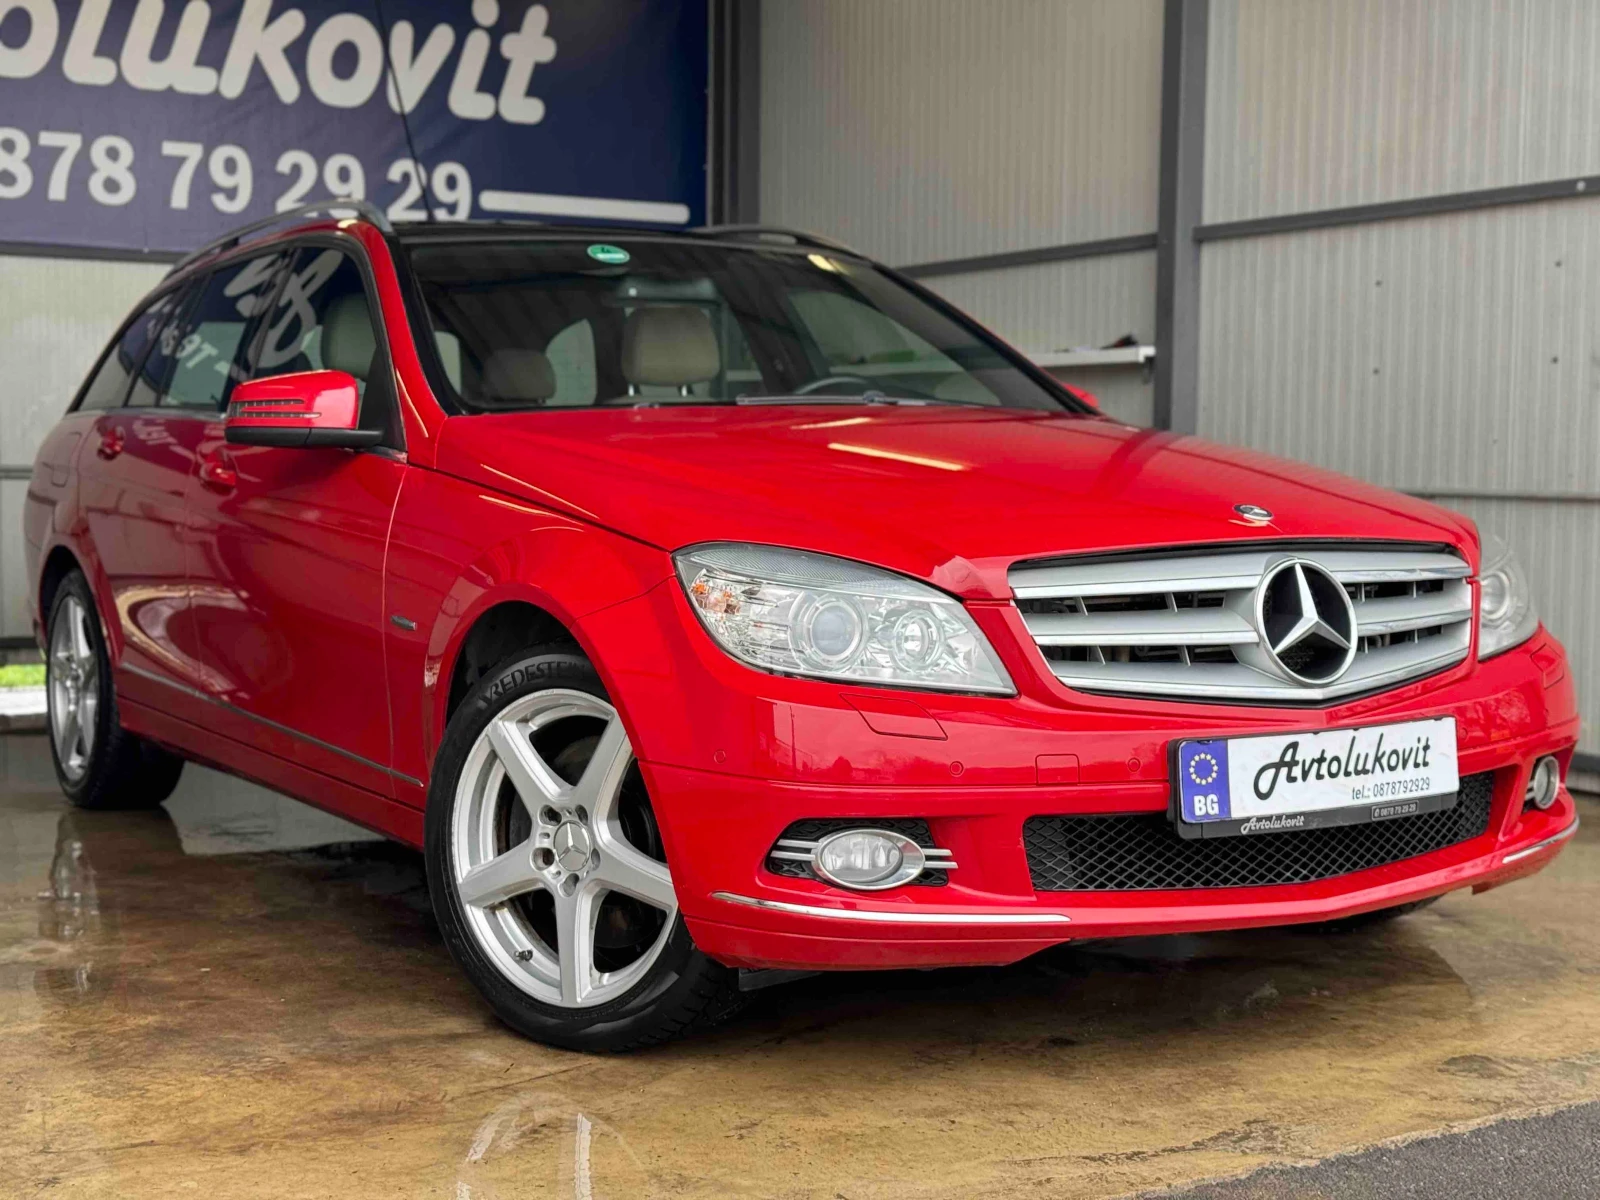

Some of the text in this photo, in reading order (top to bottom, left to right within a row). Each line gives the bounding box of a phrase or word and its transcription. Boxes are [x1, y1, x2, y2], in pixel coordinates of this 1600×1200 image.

[0, 0, 557, 124] olukovit
[0, 127, 472, 221] 878 79 29 29
[1253, 732, 1431, 800] Avtolukovit
[1373, 777, 1430, 797] 0878792929
[1194, 794, 1220, 816] BG
[1241, 815, 1304, 834] Avtolukovit
